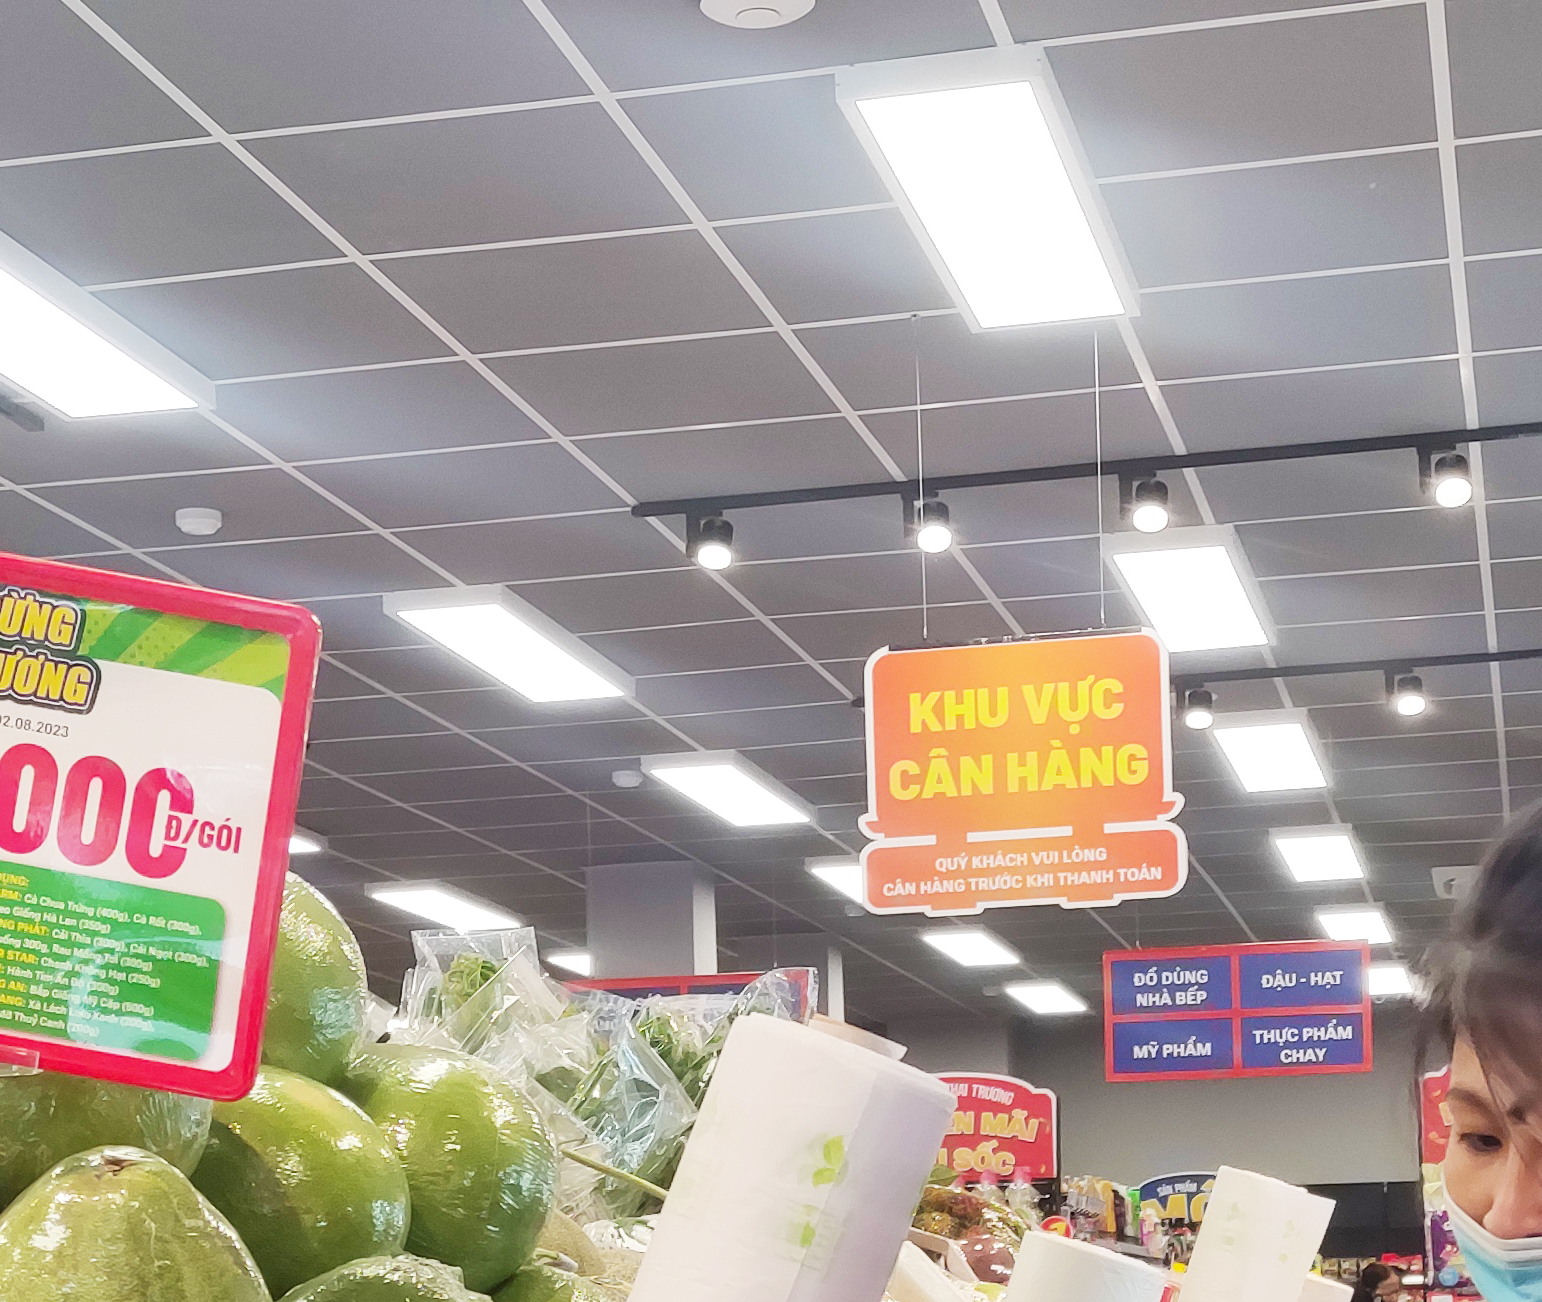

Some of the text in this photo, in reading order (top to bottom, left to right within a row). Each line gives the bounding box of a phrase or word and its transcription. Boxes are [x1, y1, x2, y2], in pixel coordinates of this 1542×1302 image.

[909, 675, 1124, 737] KHU VỰC
[889, 739, 1149, 801] CÂN HÀNG
[165, 814, 243, 855] Đ/GÓI
[935, 846, 1107, 873] QUÝ KHÁCH VUI LÒNG
[883, 862, 1163, 898] CÂN HÀNG TRƯỚC KHI THANH TOÁN
[1133, 965, 1209, 986] ĐỒ DÙNG
[1261, 971, 1297, 991] ĐẬU
[1310, 970, 1344, 989] HẠT
[1136, 984, 1208, 1007] NHÀ BẾP
[1252, 1018, 1353, 1047] THỰC PHẨM
[1133, 1036, 1212, 1061] MỸ PHẨM
[1280, 1047, 1327, 1064] CHAY
[947, 1083, 968, 1097] HAI
[980, 1108, 1039, 1142] MÃI
[953, 1140, 1016, 1175] SỐC
